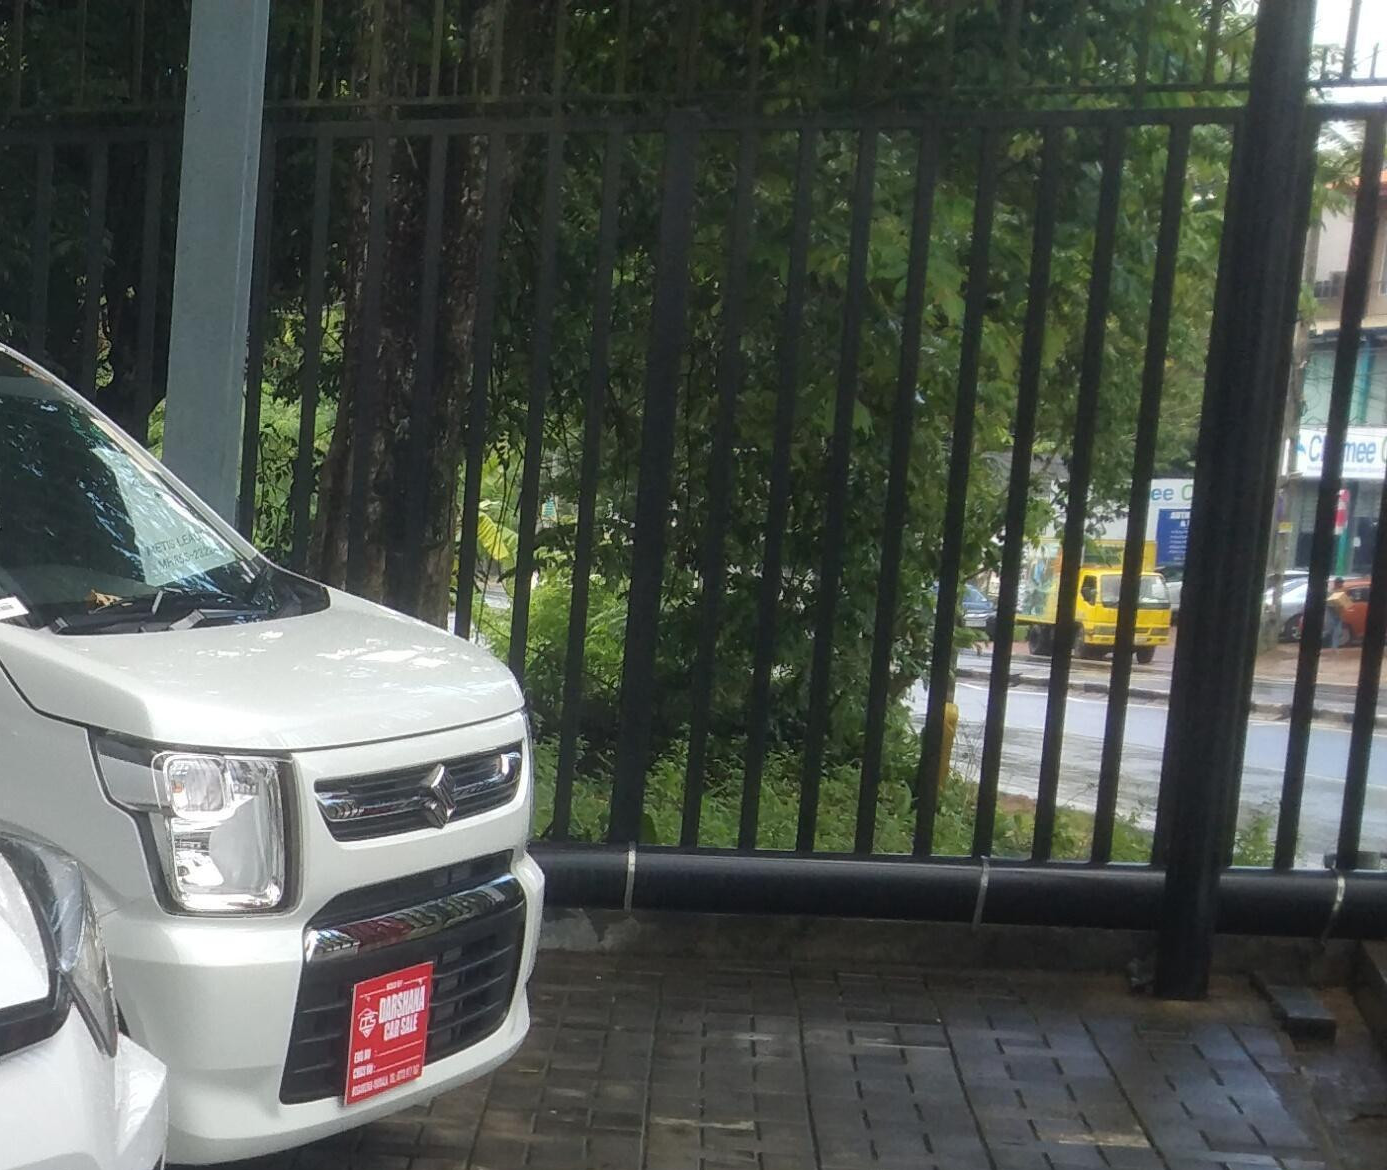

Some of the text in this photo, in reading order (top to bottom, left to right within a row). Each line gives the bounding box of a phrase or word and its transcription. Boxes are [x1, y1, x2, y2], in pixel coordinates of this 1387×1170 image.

[379, 985, 425, 1024] DARSHANA
[384, 1013, 418, 1041] CAR SALE
